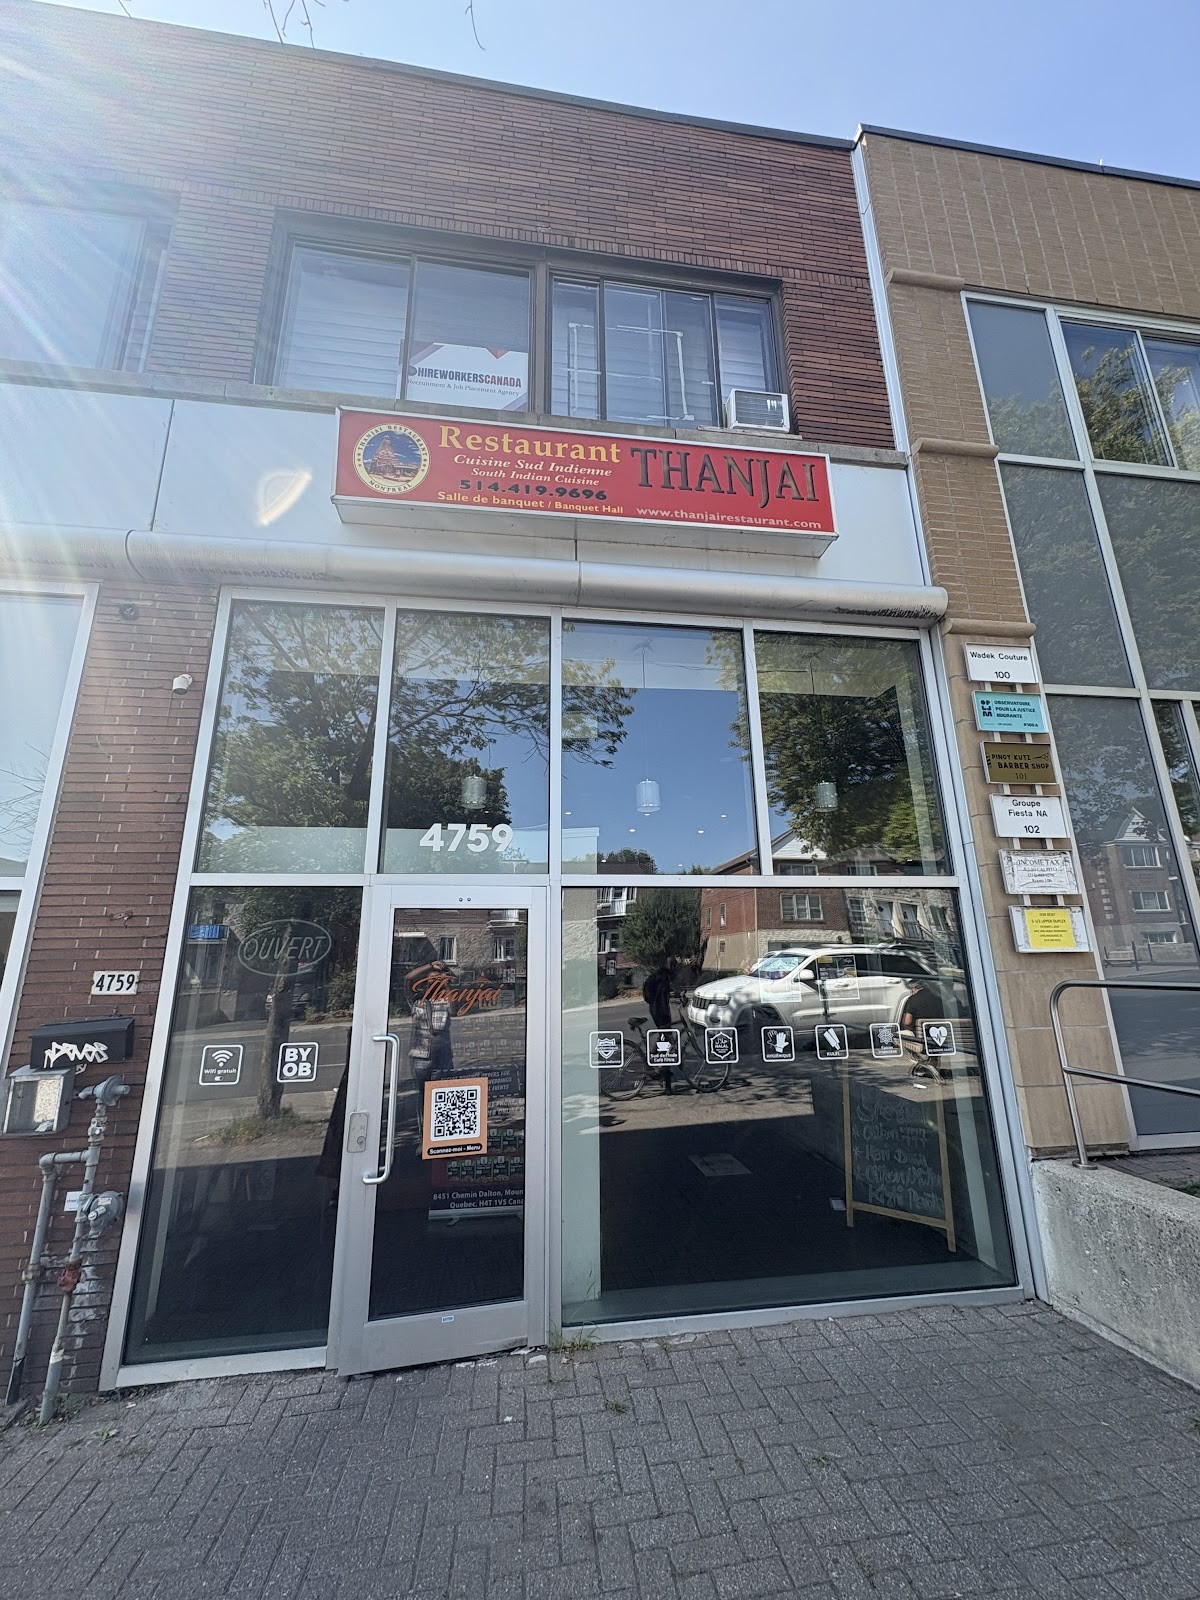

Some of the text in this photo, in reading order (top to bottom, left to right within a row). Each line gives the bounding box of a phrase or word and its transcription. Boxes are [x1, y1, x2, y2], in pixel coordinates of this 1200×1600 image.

[417, 367, 522, 388] HIREWORKERSCANADA
[465, 385, 496, 394] Placement
[497, 389, 520, 397] Agency
[438, 425, 819, 508] Restaurant THANJAI
[453, 454, 613, 477] Cuisine Sud Indienne
[471, 467, 600, 486] South Indian Cuisine
[368, 480, 412, 492] MONTREAL
[459, 479, 608, 501] 514.419.9696
[437, 491, 624, 514] Salle de banquet / Banquet Hall
[636, 507, 822, 529] www.thanjairestaurant.com
[970, 651, 1028, 661] Wadek Couture
[994, 671, 1011, 679] 100
[997, 762, 1030, 770] BARBER
[1012, 799, 1041, 808] Groupe
[1008, 809, 1048, 818] Fiesta NA
[419, 822, 514, 852] 4759
[1023, 825, 1040, 834] 102
[243, 936, 326, 960] OUVERT
[95, 974, 135, 992] 4759
[285, 1047, 312, 1062] BY
[282, 1062, 312, 1077] OB
[429, 1146, 462, 1155] Scannez-moi
[451, 1191, 478, 1199] Chemin
